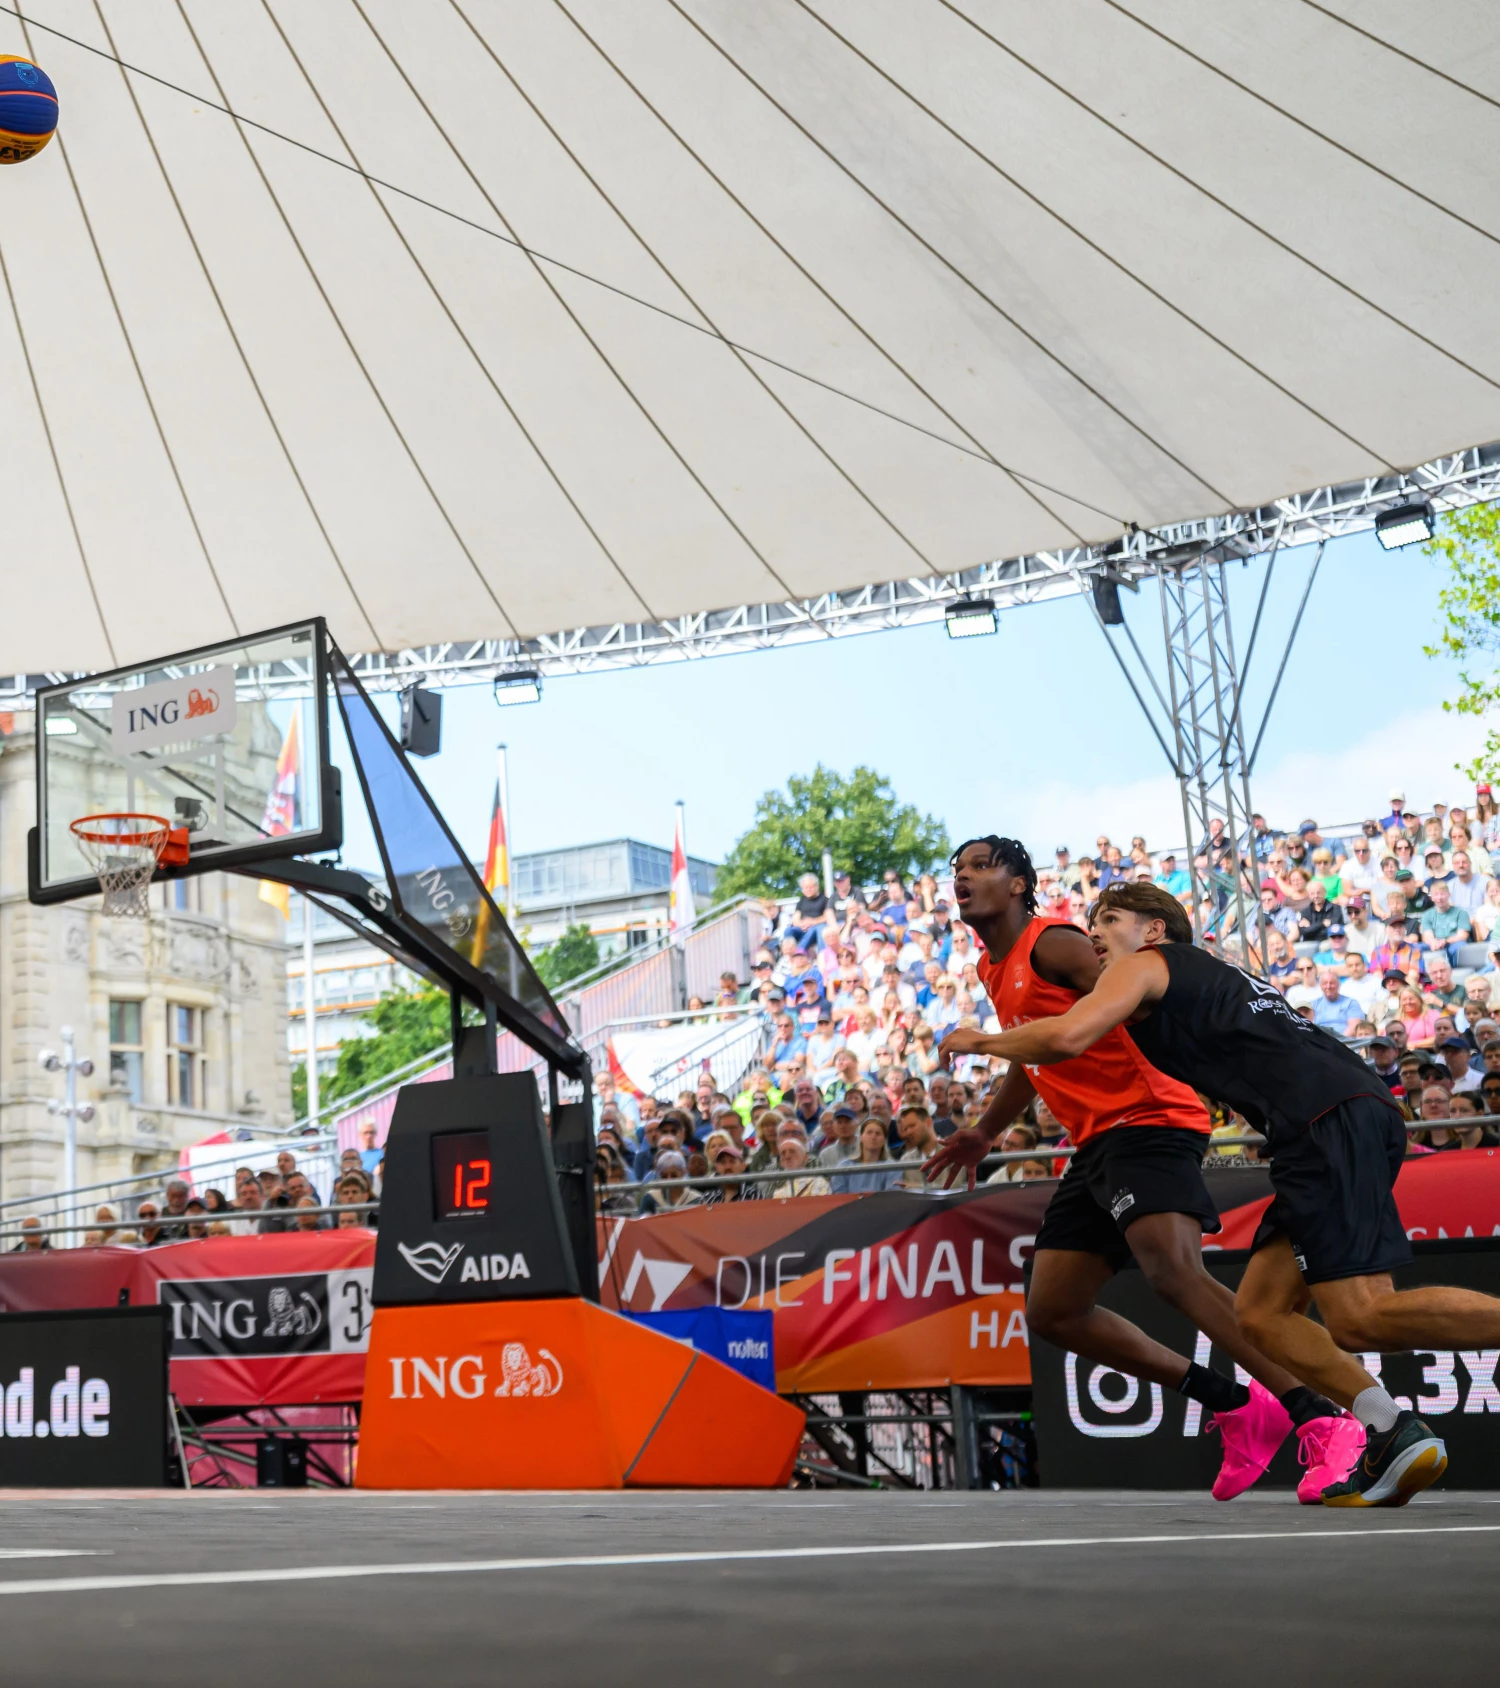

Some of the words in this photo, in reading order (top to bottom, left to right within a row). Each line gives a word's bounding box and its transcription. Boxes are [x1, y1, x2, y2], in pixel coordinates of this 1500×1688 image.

[128, 699, 180, 734] ING
[415, 864, 455, 911] ING
[455, 1160, 491, 1208] 12
[460, 1252, 531, 1283] AIDA
[716, 1252, 805, 1309] DIE
[172, 1299, 258, 1340] ING
[388, 1355, 487, 1399] ING
